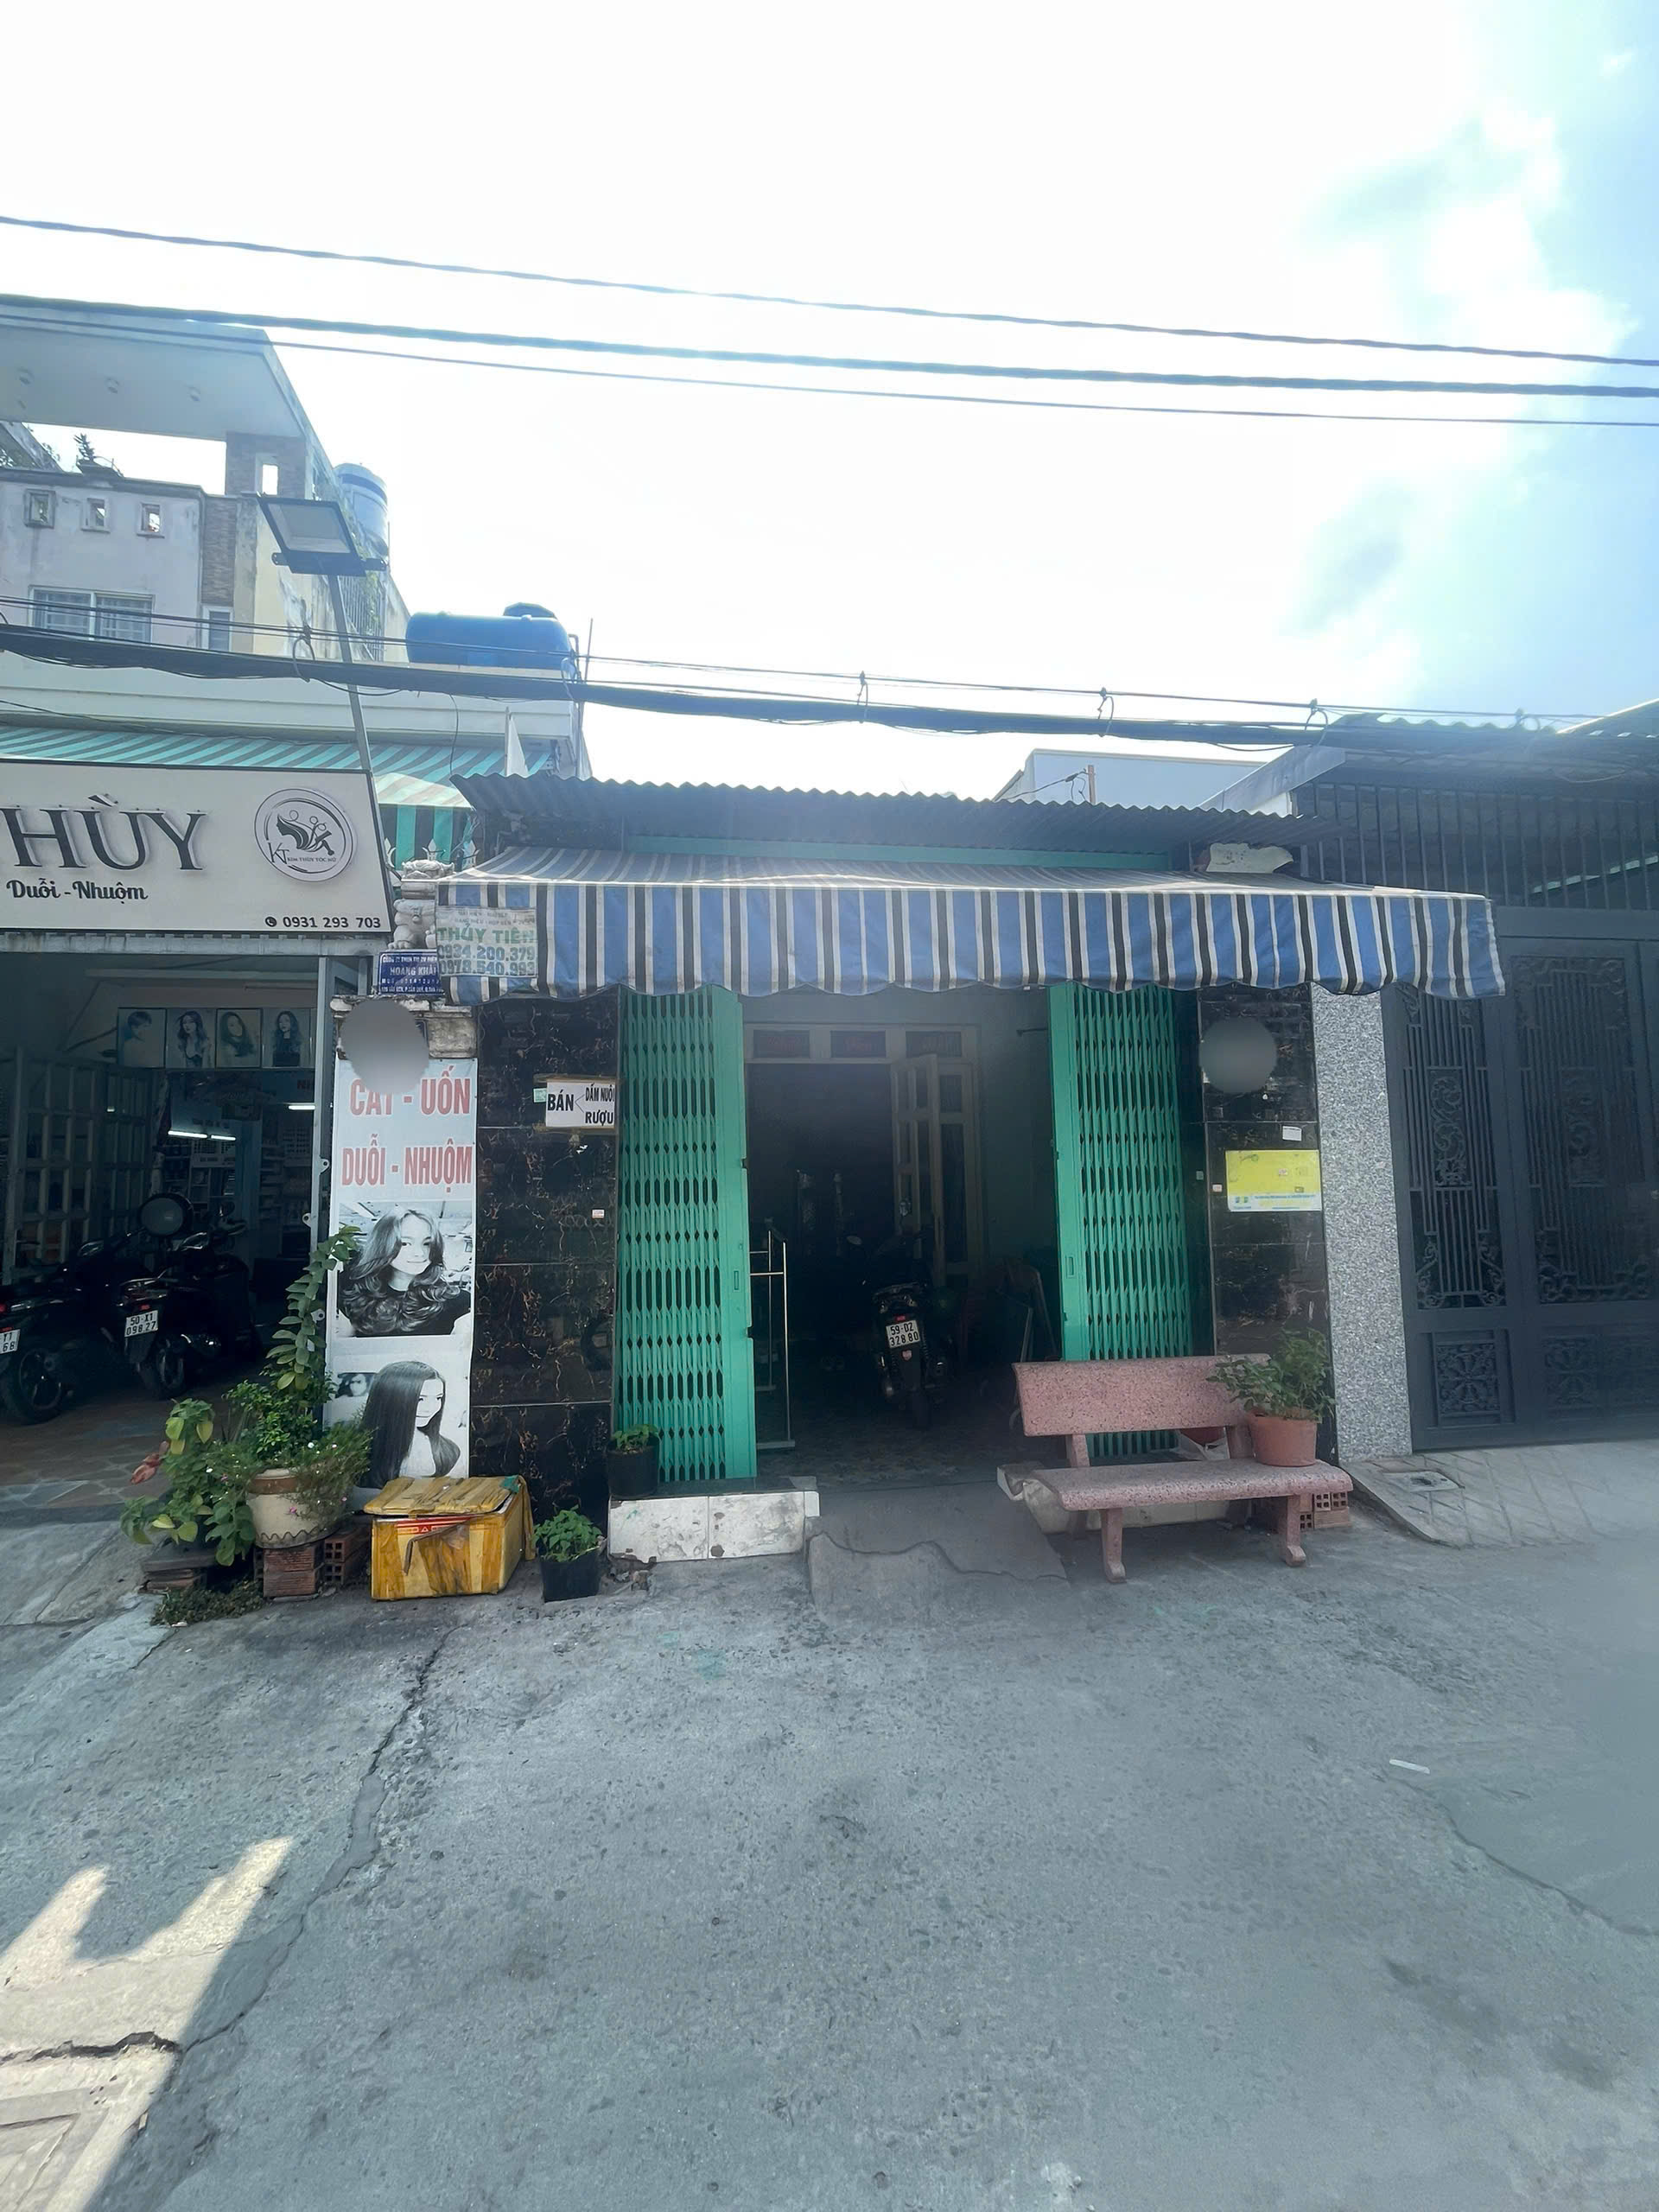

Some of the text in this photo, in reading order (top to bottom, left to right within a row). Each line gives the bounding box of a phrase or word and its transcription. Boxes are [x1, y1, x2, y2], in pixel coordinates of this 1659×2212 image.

[6, 878, 60, 899] Duỗi
[73, 881, 148, 904] Nhuộm
[283, 917, 381, 928] 0931 293 703
[436, 923, 535, 944] THỦY TIÊN
[422, 1065, 471, 1115] UỐN
[547, 1089, 574, 1111] BÁN
[585, 1109, 613, 1127] RƯỢU
[341, 1133, 386, 1185] DUỖI
[404, 1138, 473, 1193] NHUỘM
